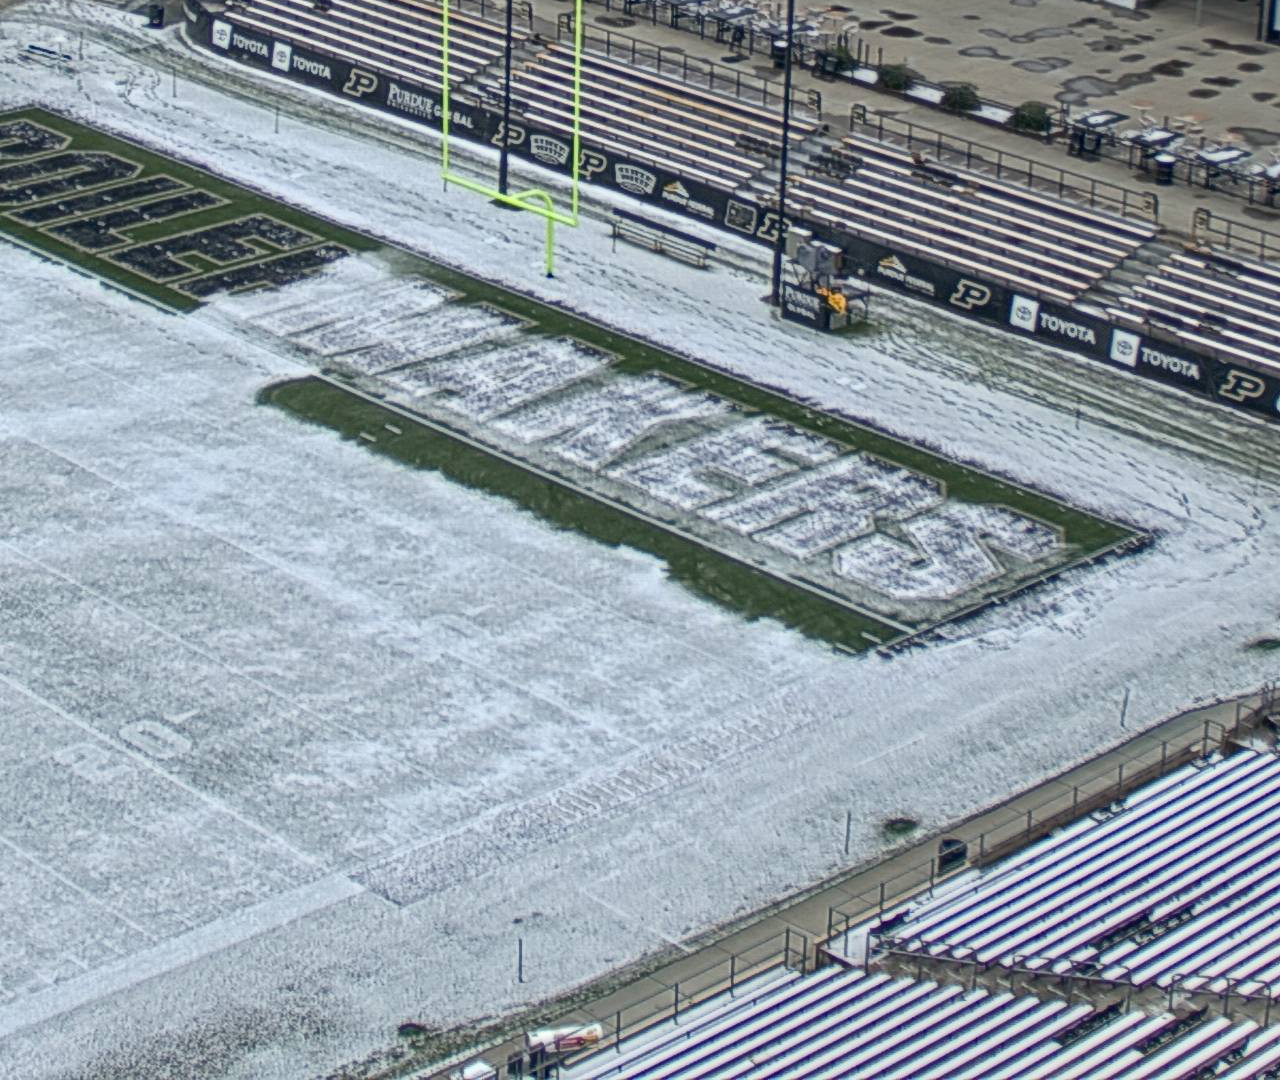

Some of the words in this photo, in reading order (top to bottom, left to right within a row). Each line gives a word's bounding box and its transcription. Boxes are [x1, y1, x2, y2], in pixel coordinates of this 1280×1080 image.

[232, 32, 270, 59] TOYOTA
[292, 56, 332, 81] TOYOTA
[342, 67, 378, 98] P
[388, 82, 435, 113] PURDUE
[949, 278, 991, 311] P
[1040, 312, 1097, 345] TOYOTA
[1140, 346, 1201, 380] TOYOTA
[1219, 369, 1266, 403] P
